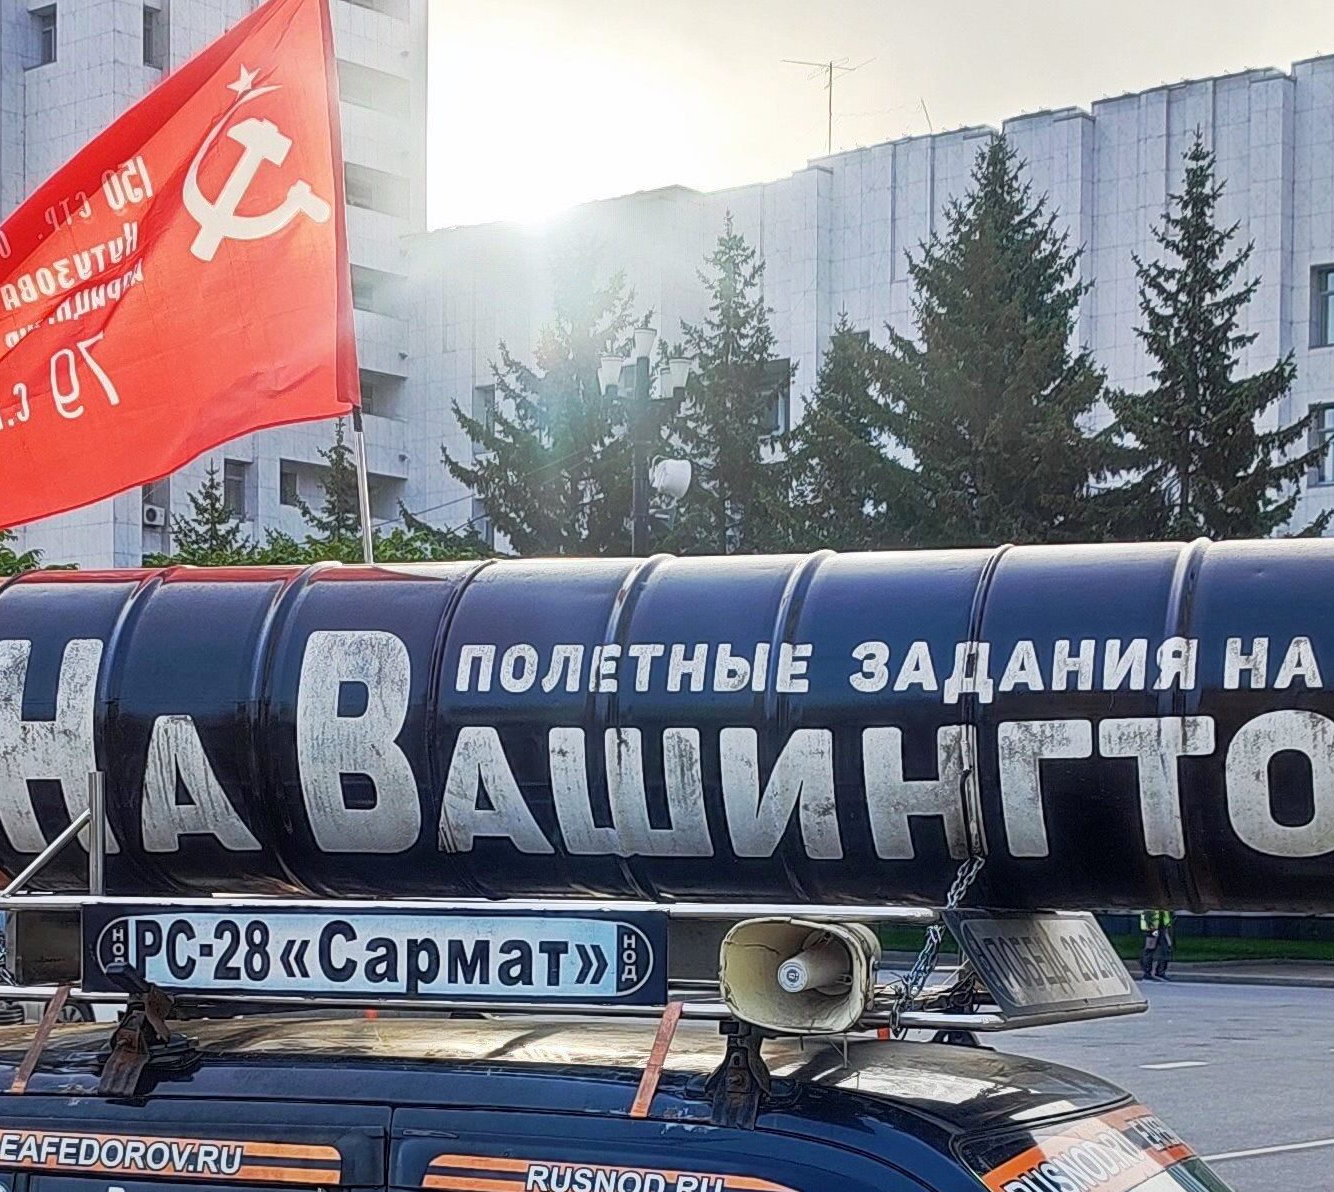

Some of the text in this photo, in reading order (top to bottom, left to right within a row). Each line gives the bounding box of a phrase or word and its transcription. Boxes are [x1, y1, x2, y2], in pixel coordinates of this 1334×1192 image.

[455, 642, 813, 693] ПОЛЕТНЫЕ
[849, 637, 1199, 704] ЗАДАНИЯ
[1224, 636, 1323, 690] НА
[280, 919, 610, 998] «Сармат»
[621, 934, 638, 982] НОД
